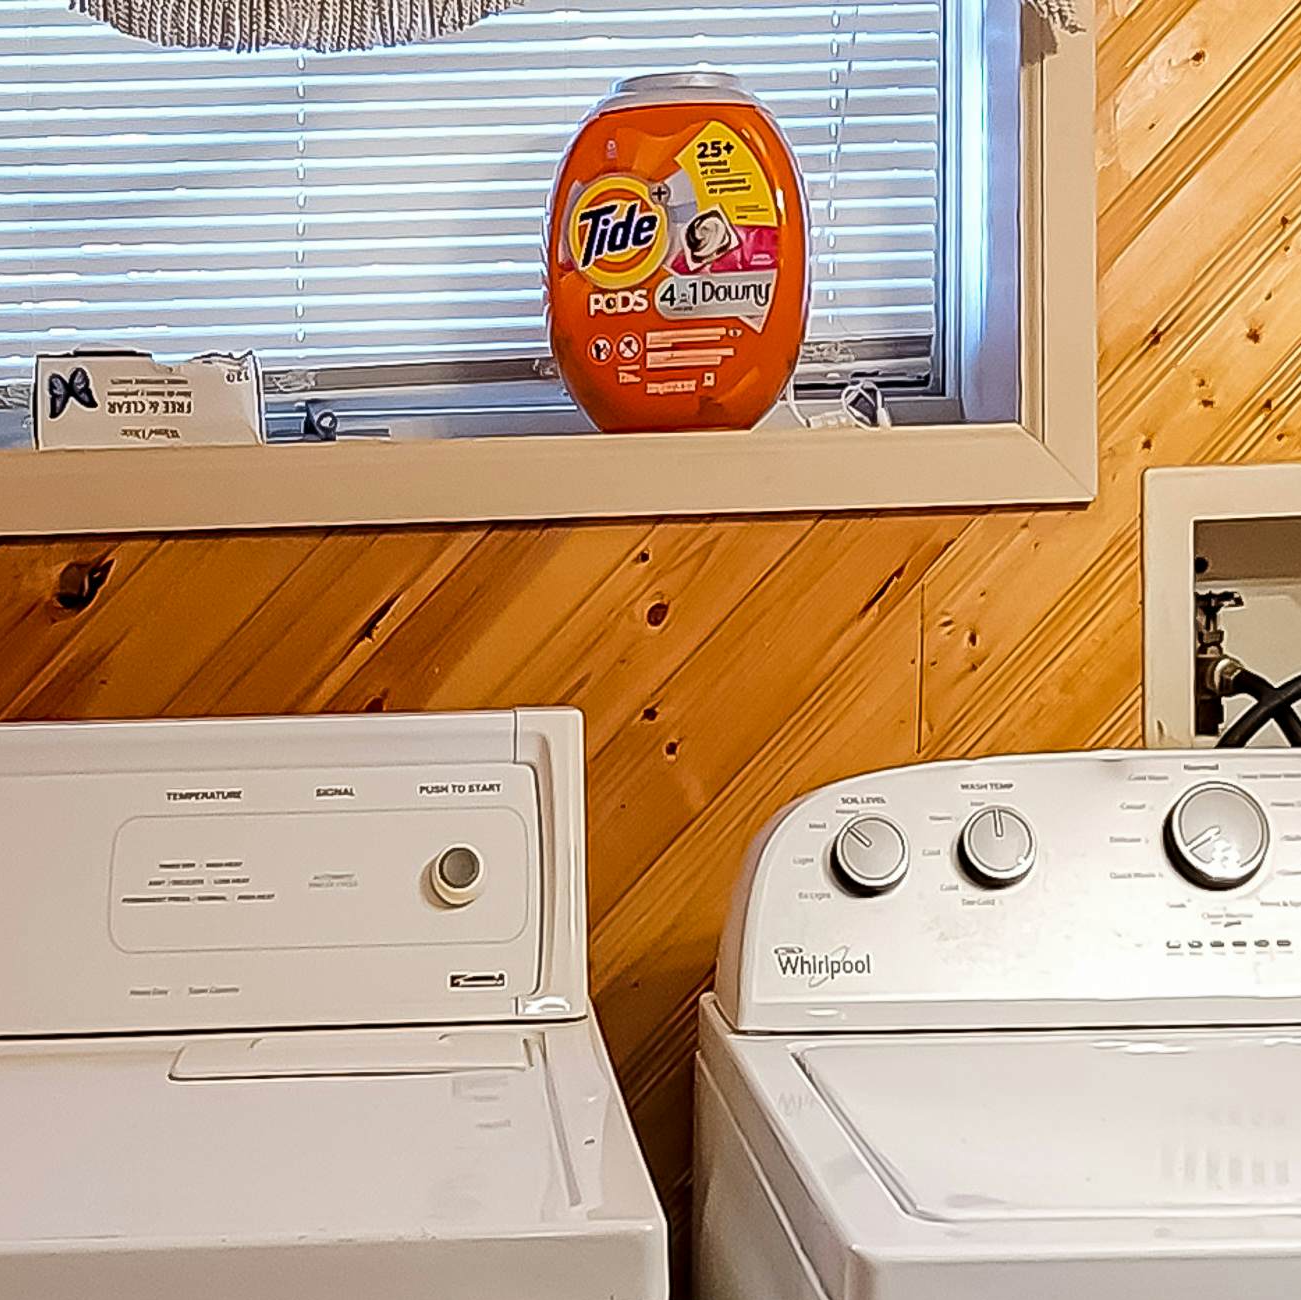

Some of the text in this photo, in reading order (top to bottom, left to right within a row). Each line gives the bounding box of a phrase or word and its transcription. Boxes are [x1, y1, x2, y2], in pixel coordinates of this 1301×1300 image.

[696, 140, 734, 159] 25+
[579, 202, 659, 268] Tide
[589, 288, 649, 316] PODS
[659, 283, 676, 306] 4
[702, 281, 772, 306] Downy
[107, 401, 192, 415] FREE & CLEAR
[315, 787, 355, 798] SIGNAL
[419, 783, 501, 795] PUSH TO START
[989, 782, 1014, 790] TEMP
[166, 790, 243, 802] TEMPERATURE
[778, 953, 871, 980] Whirlpool
